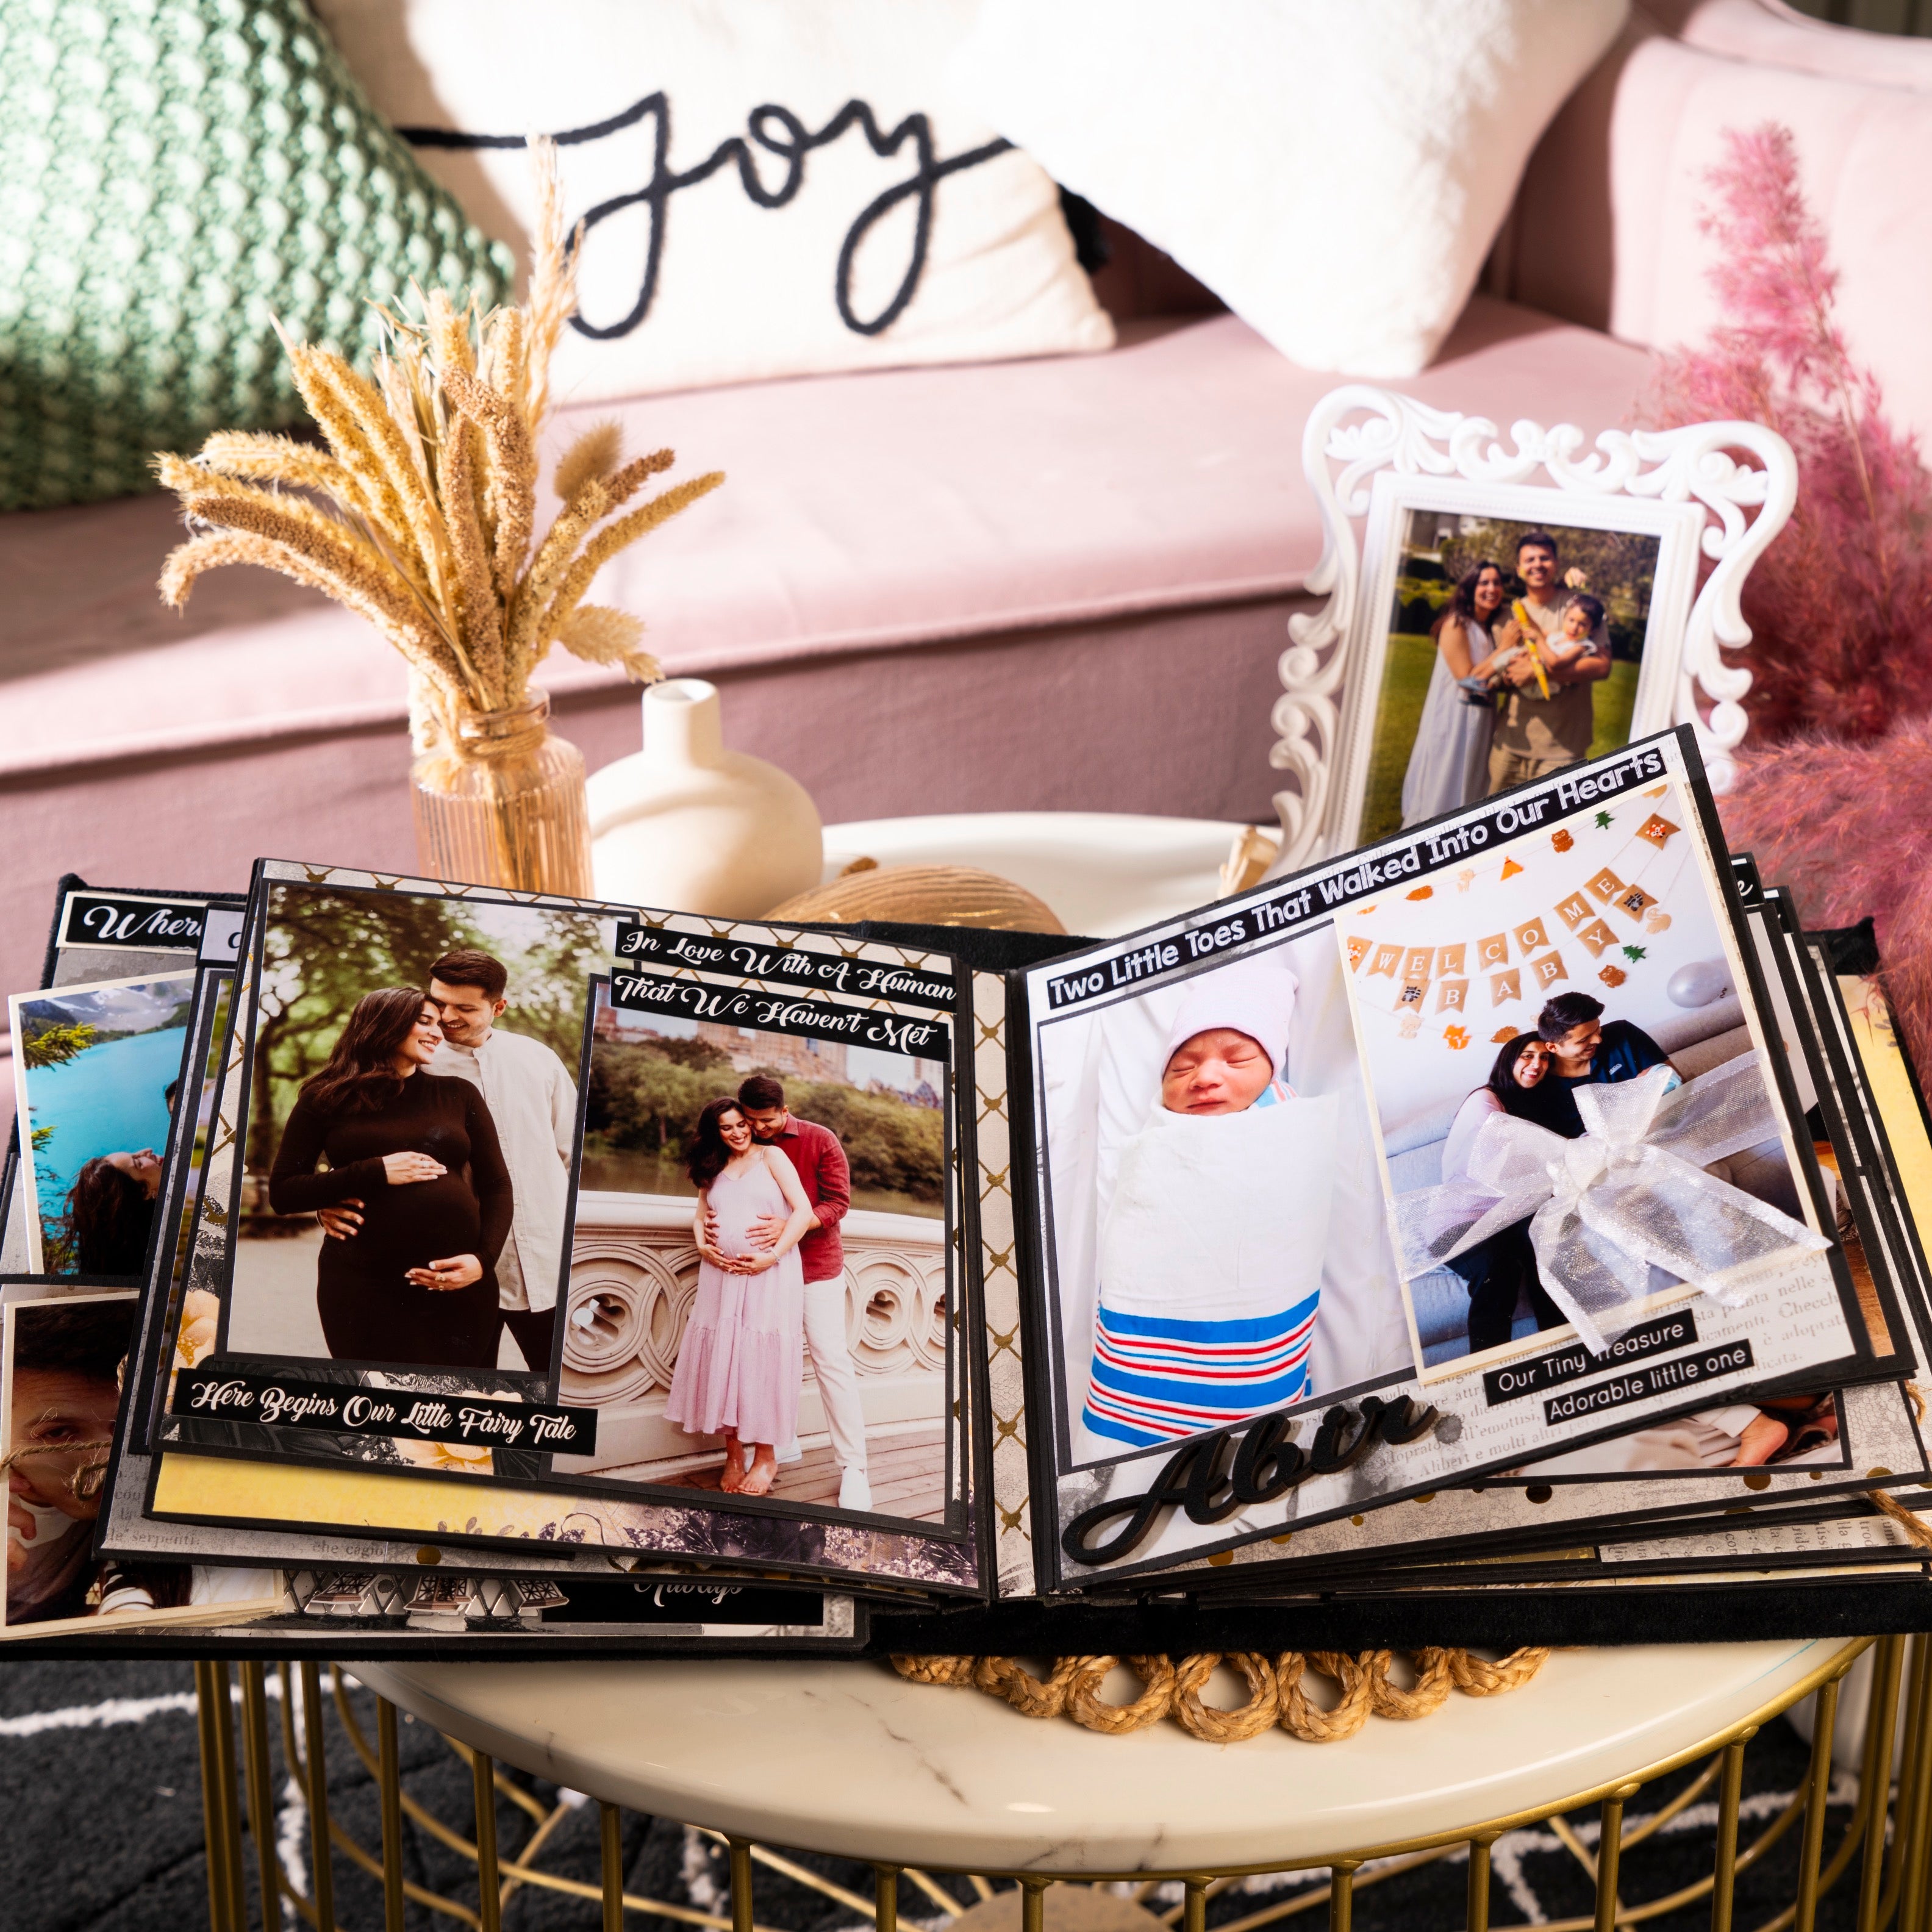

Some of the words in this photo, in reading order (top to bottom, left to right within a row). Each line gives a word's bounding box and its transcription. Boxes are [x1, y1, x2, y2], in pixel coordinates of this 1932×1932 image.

[1050, 978, 1104, 1004] Two
[1111, 943, 1179, 986] Little
[1185, 919, 1246, 957] Toes
[1251, 890, 1311, 932] That
[1318, 846, 1420, 905] Walked
[1425, 825, 1488, 865] Into
[1496, 797, 1550, 834] Our
[1556, 753, 1661, 810] Hearts
[621, 931, 660, 953] In
[667, 937, 724, 965] Love
[731, 946, 815, 976] With
[818, 962, 851, 992] A
[857, 968, 957, 1000] Human
[615, 975, 684, 1003] That
[680, 987, 749, 1016] We
[755, 1001, 870, 1032] Haven't
[867, 1018, 938, 1054] Met
[1498, 1368, 1536, 1393] Our
[1542, 1353, 1587, 1378] Tiny
[1597, 1324, 1684, 1362] reasure
[1550, 1378, 1644, 1420] Adorable
[1650, 1361, 1699, 1389] little
[1706, 1348, 1747, 1372] one
[190, 1380, 255, 1411] Here
[260, 1387, 337, 1423] Begins
[342, 1395, 396, 1427] Our
[401, 1401, 454, 1436] Little
[458, 1406, 524, 1444] Fairy
[528, 1414, 577, 1444] Tale
